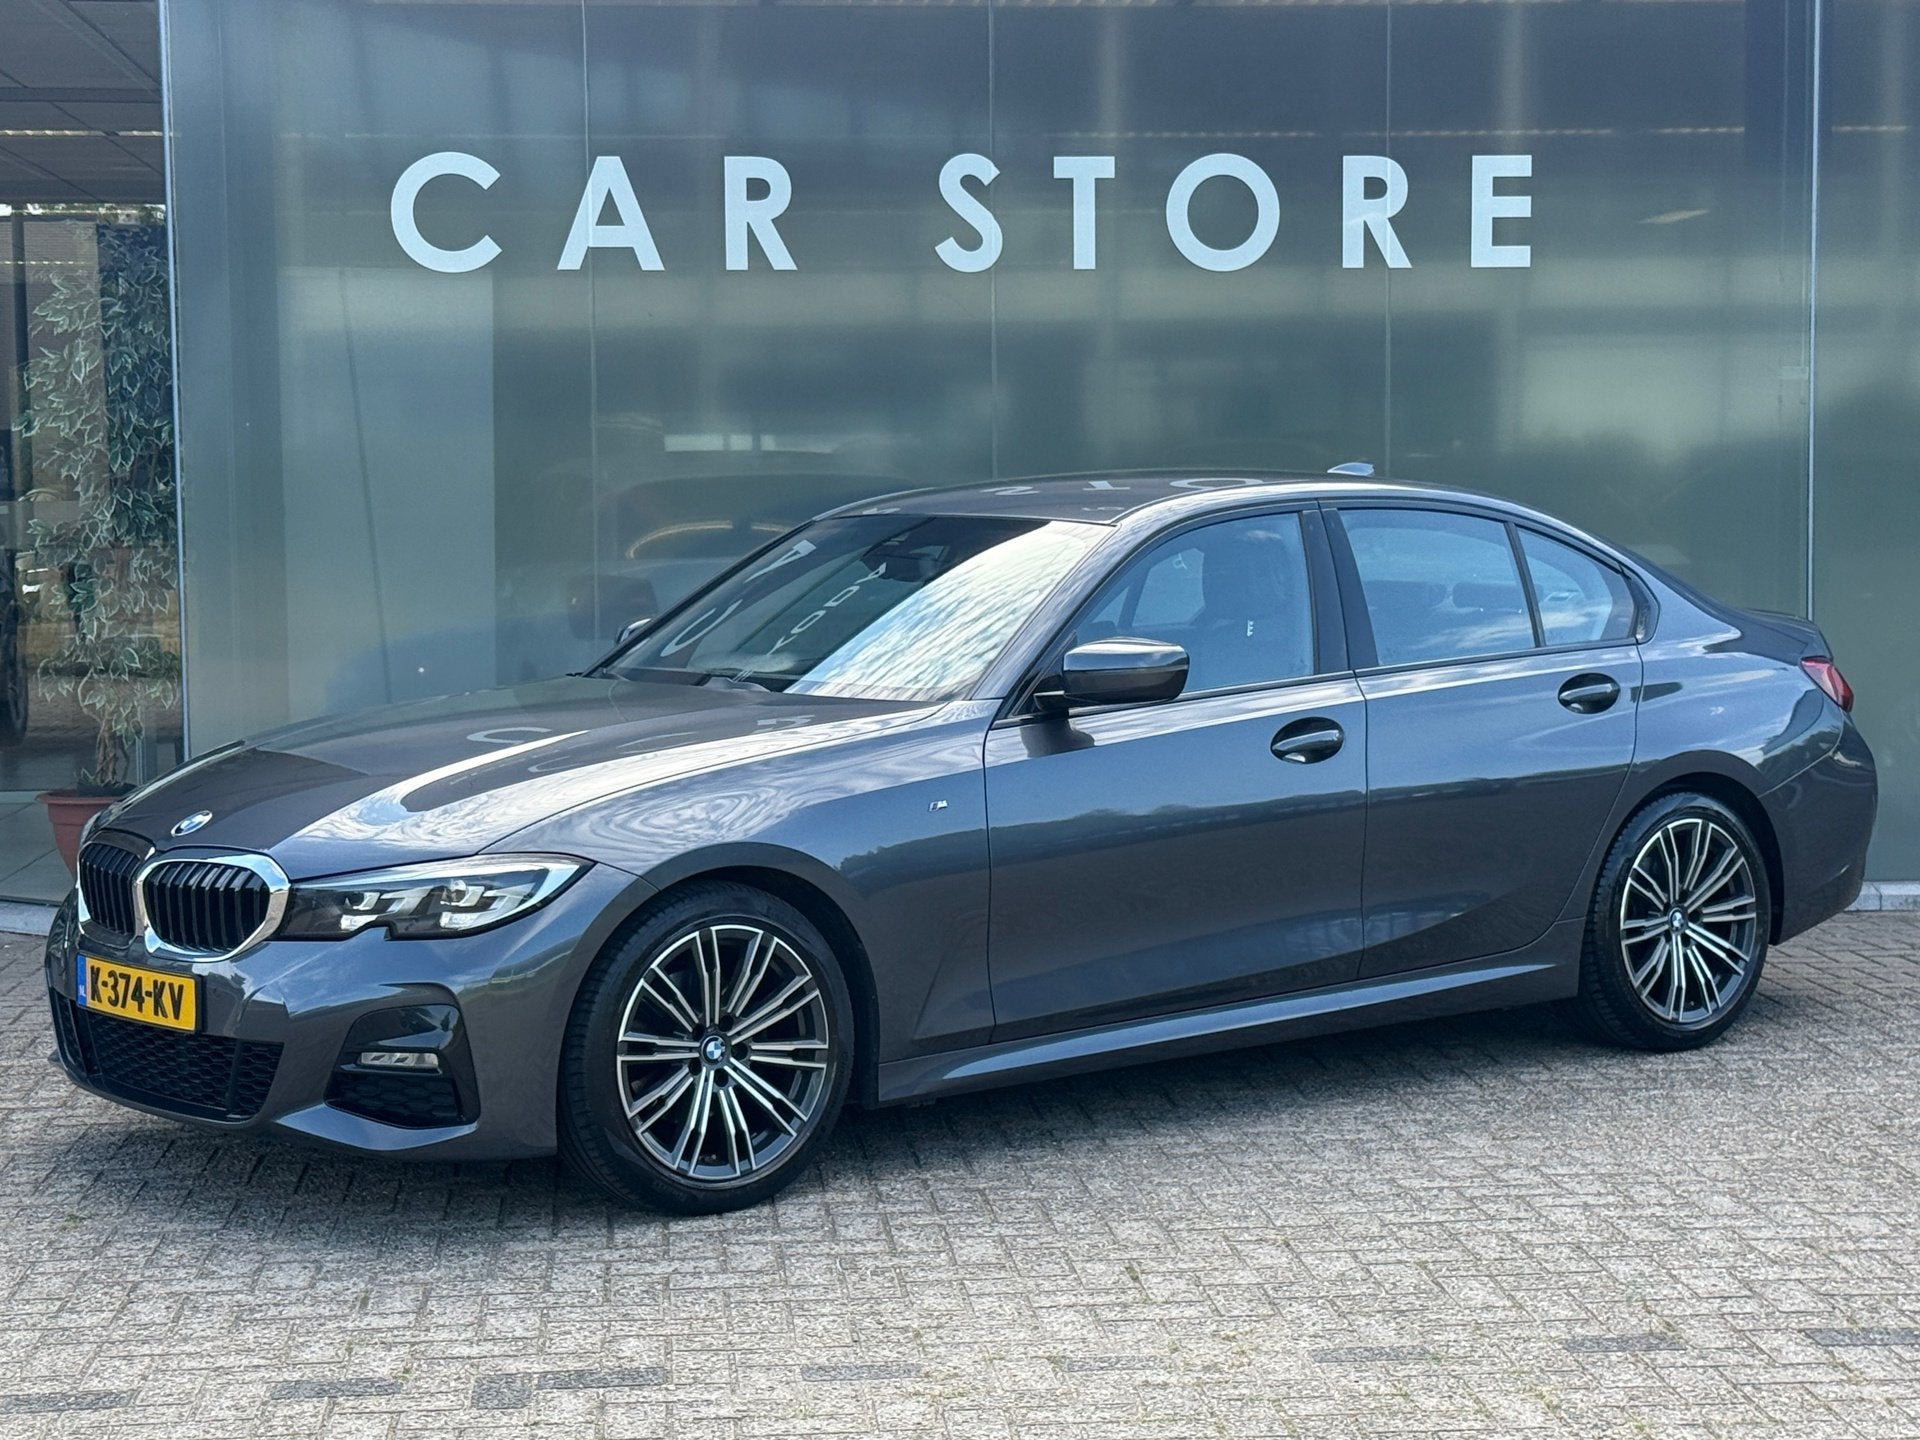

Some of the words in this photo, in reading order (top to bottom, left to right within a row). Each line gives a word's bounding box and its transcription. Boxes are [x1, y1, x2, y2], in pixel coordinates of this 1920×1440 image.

[390, 151, 798, 273] CAR
[934, 152, 1533, 273] STORE
[90, 965, 184, 1020] K-374-KV
